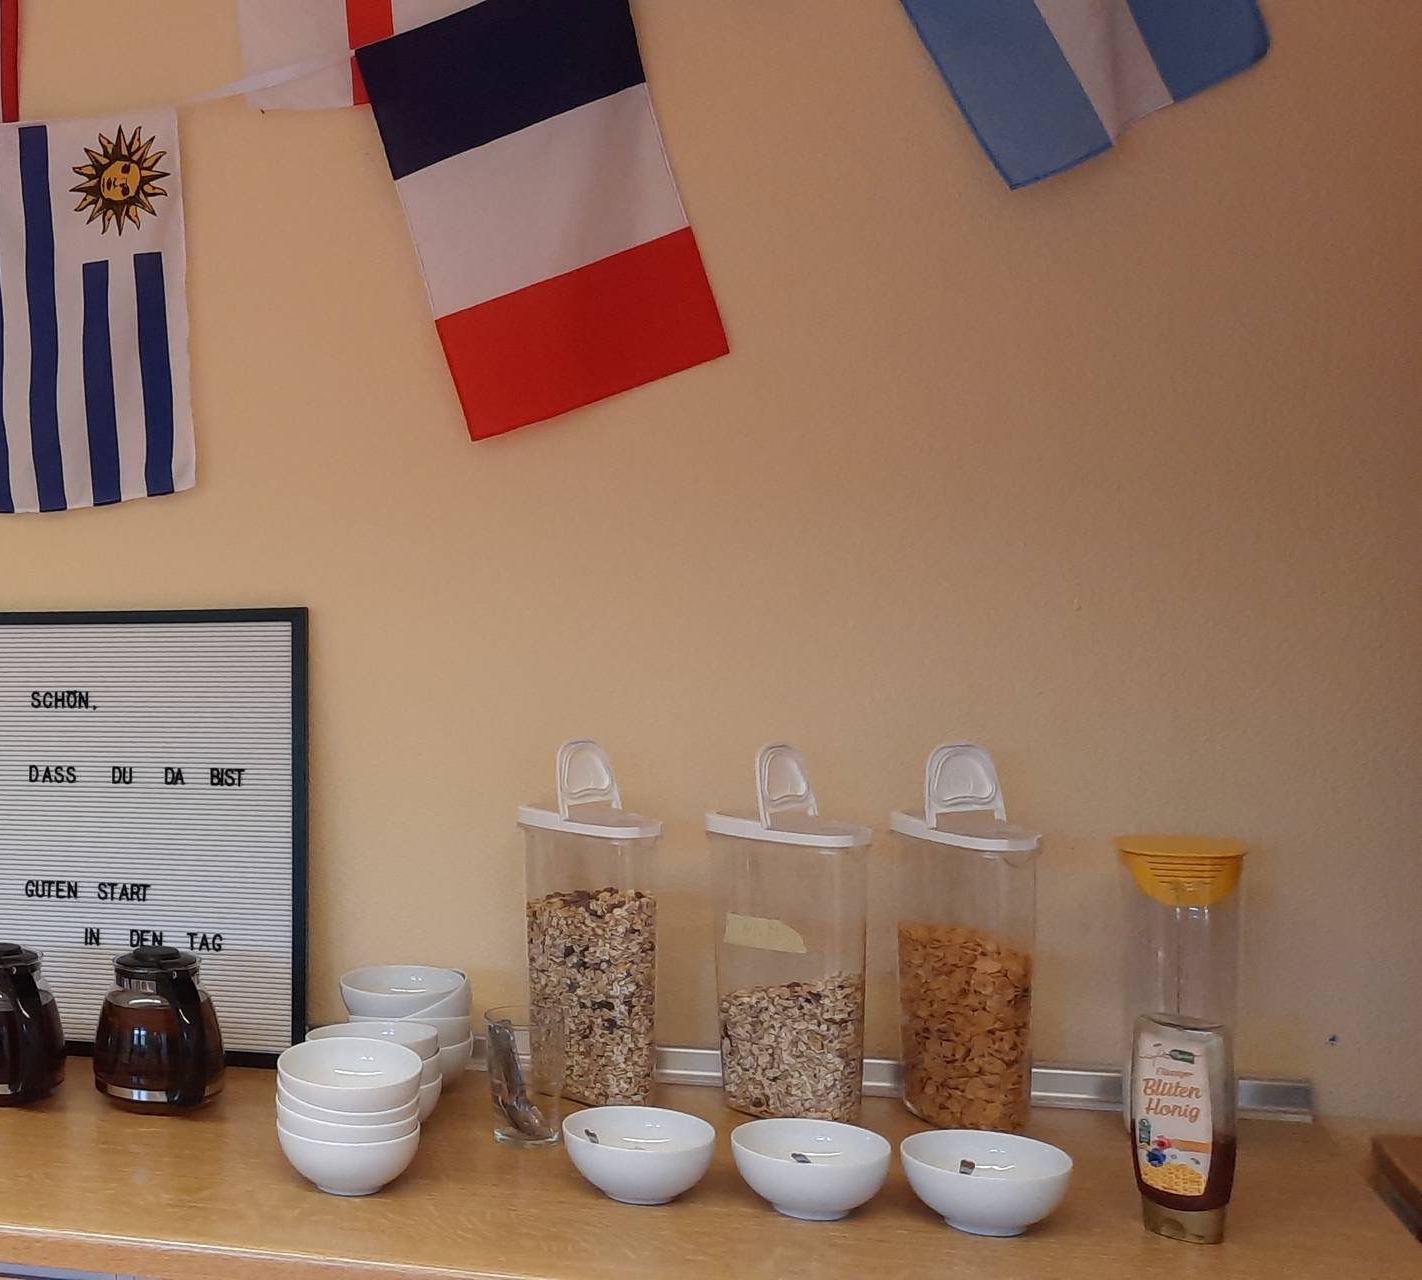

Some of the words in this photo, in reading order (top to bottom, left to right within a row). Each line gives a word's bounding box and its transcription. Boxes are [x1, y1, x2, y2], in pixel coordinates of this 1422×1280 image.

[28, 765, 77, 783] DASS
[111, 766, 133, 784] DU
[164, 767, 185, 785] DA
[210, 767, 246, 787] BIST
[24, 880, 78, 899] GUTEN
[97, 882, 151, 901] START
[84, 928, 100, 946] IN
[130, 929, 163, 947] DEN
[187, 932, 223, 952] TAG
[1145, 1098, 1200, 1123] Honig
